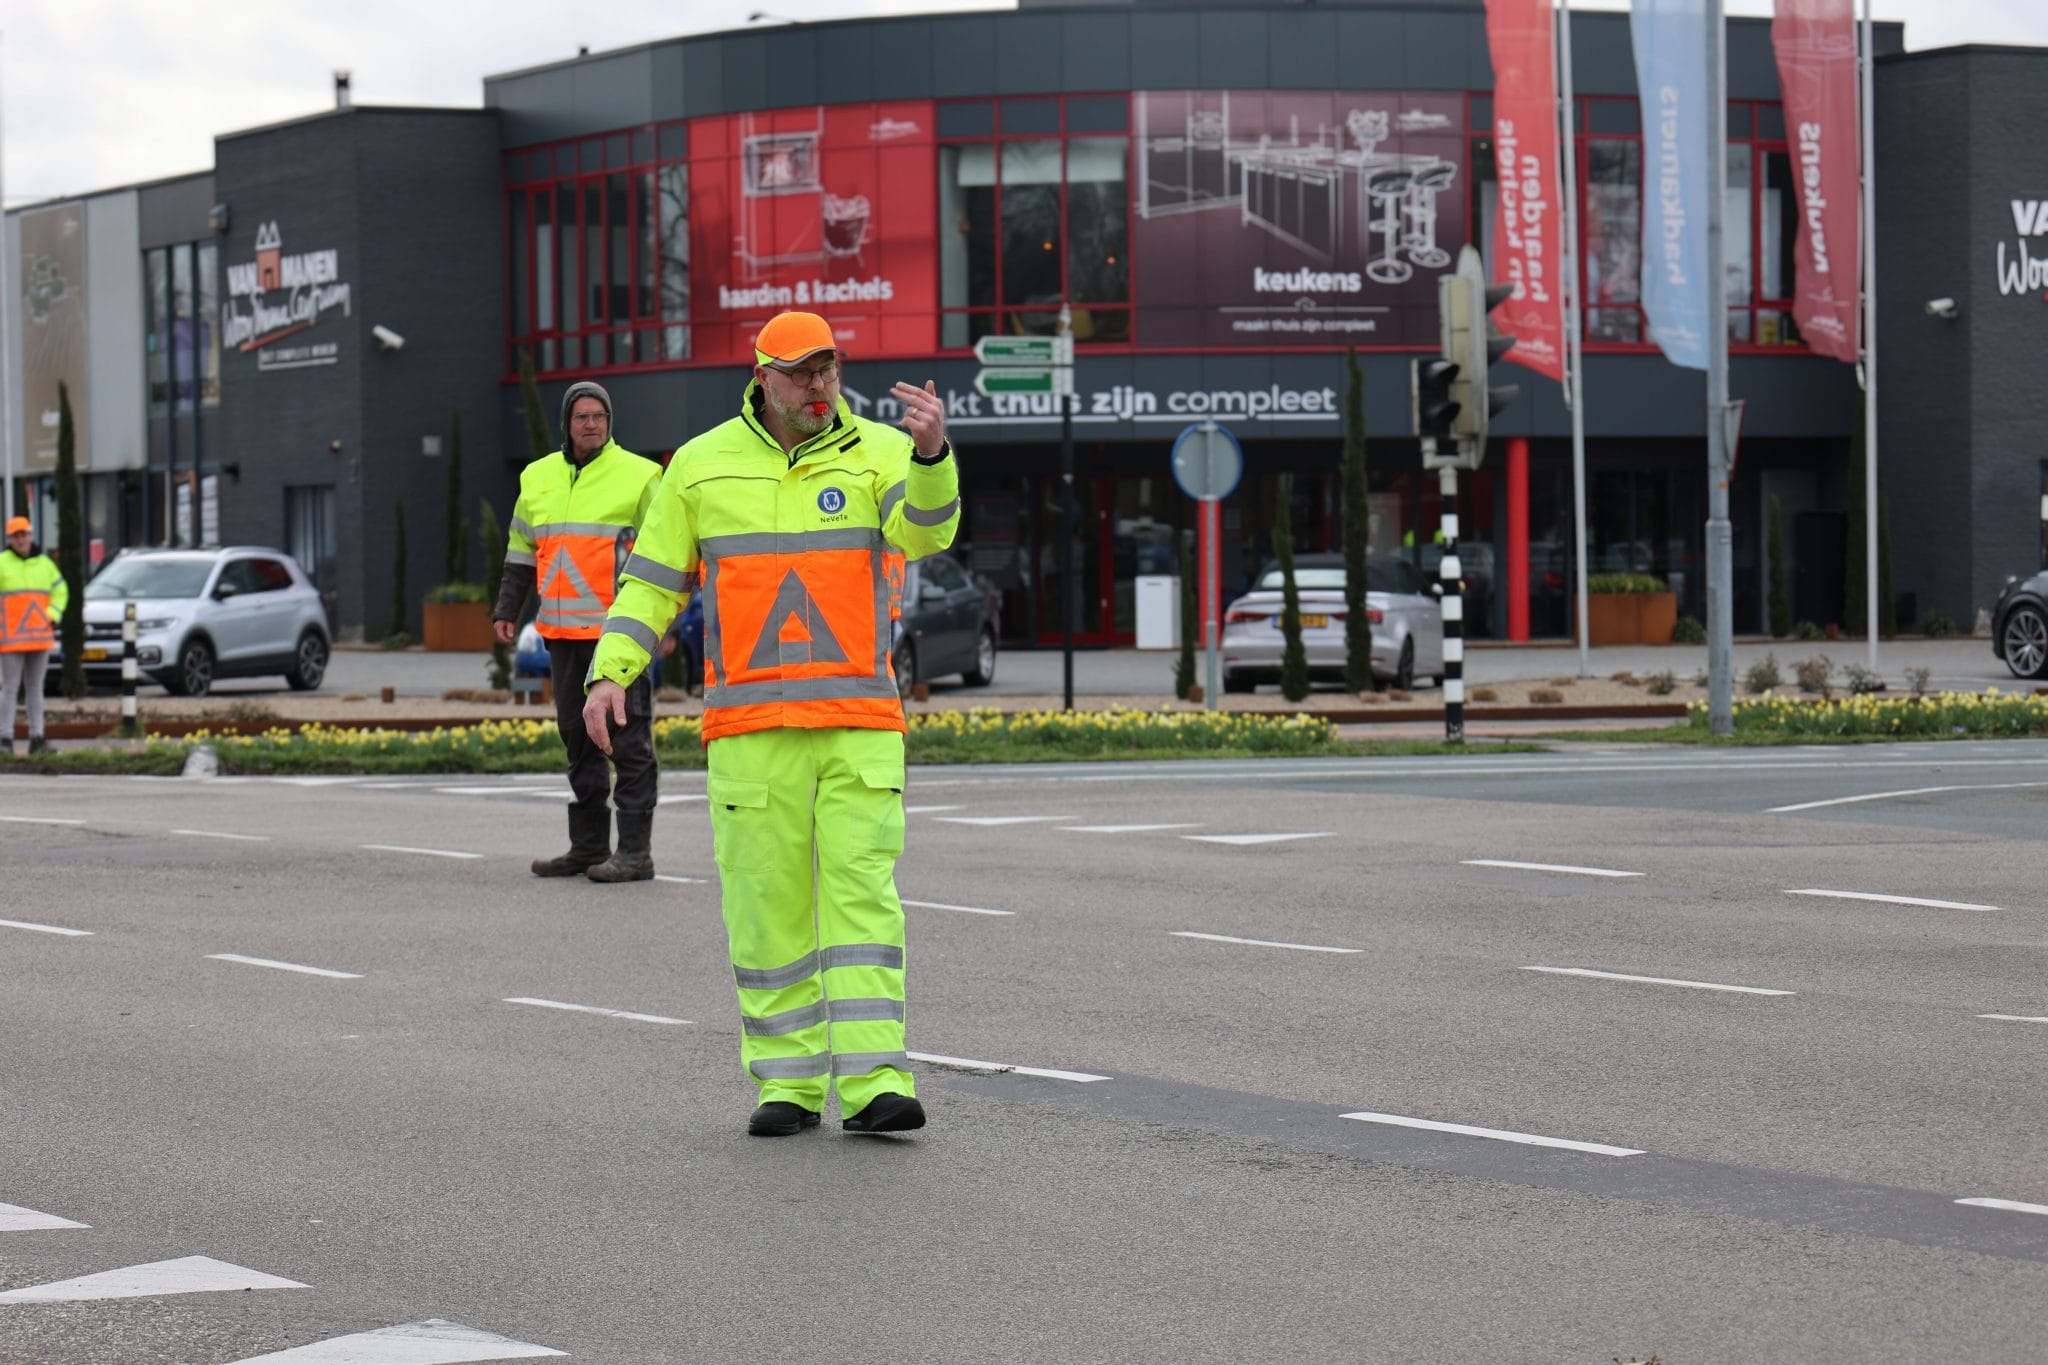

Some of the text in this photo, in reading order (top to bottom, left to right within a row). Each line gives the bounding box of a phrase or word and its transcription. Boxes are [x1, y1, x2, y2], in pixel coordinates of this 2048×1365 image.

[280, 249, 338, 288] MANEN
[1254, 266, 1362, 292] keukens
[719, 275, 893, 309] haarden & kachels
[1092, 385, 1156, 419] zijn
[1167, 384, 1337, 418] compleet
[820, 514, 848, 524] NeVeTe
